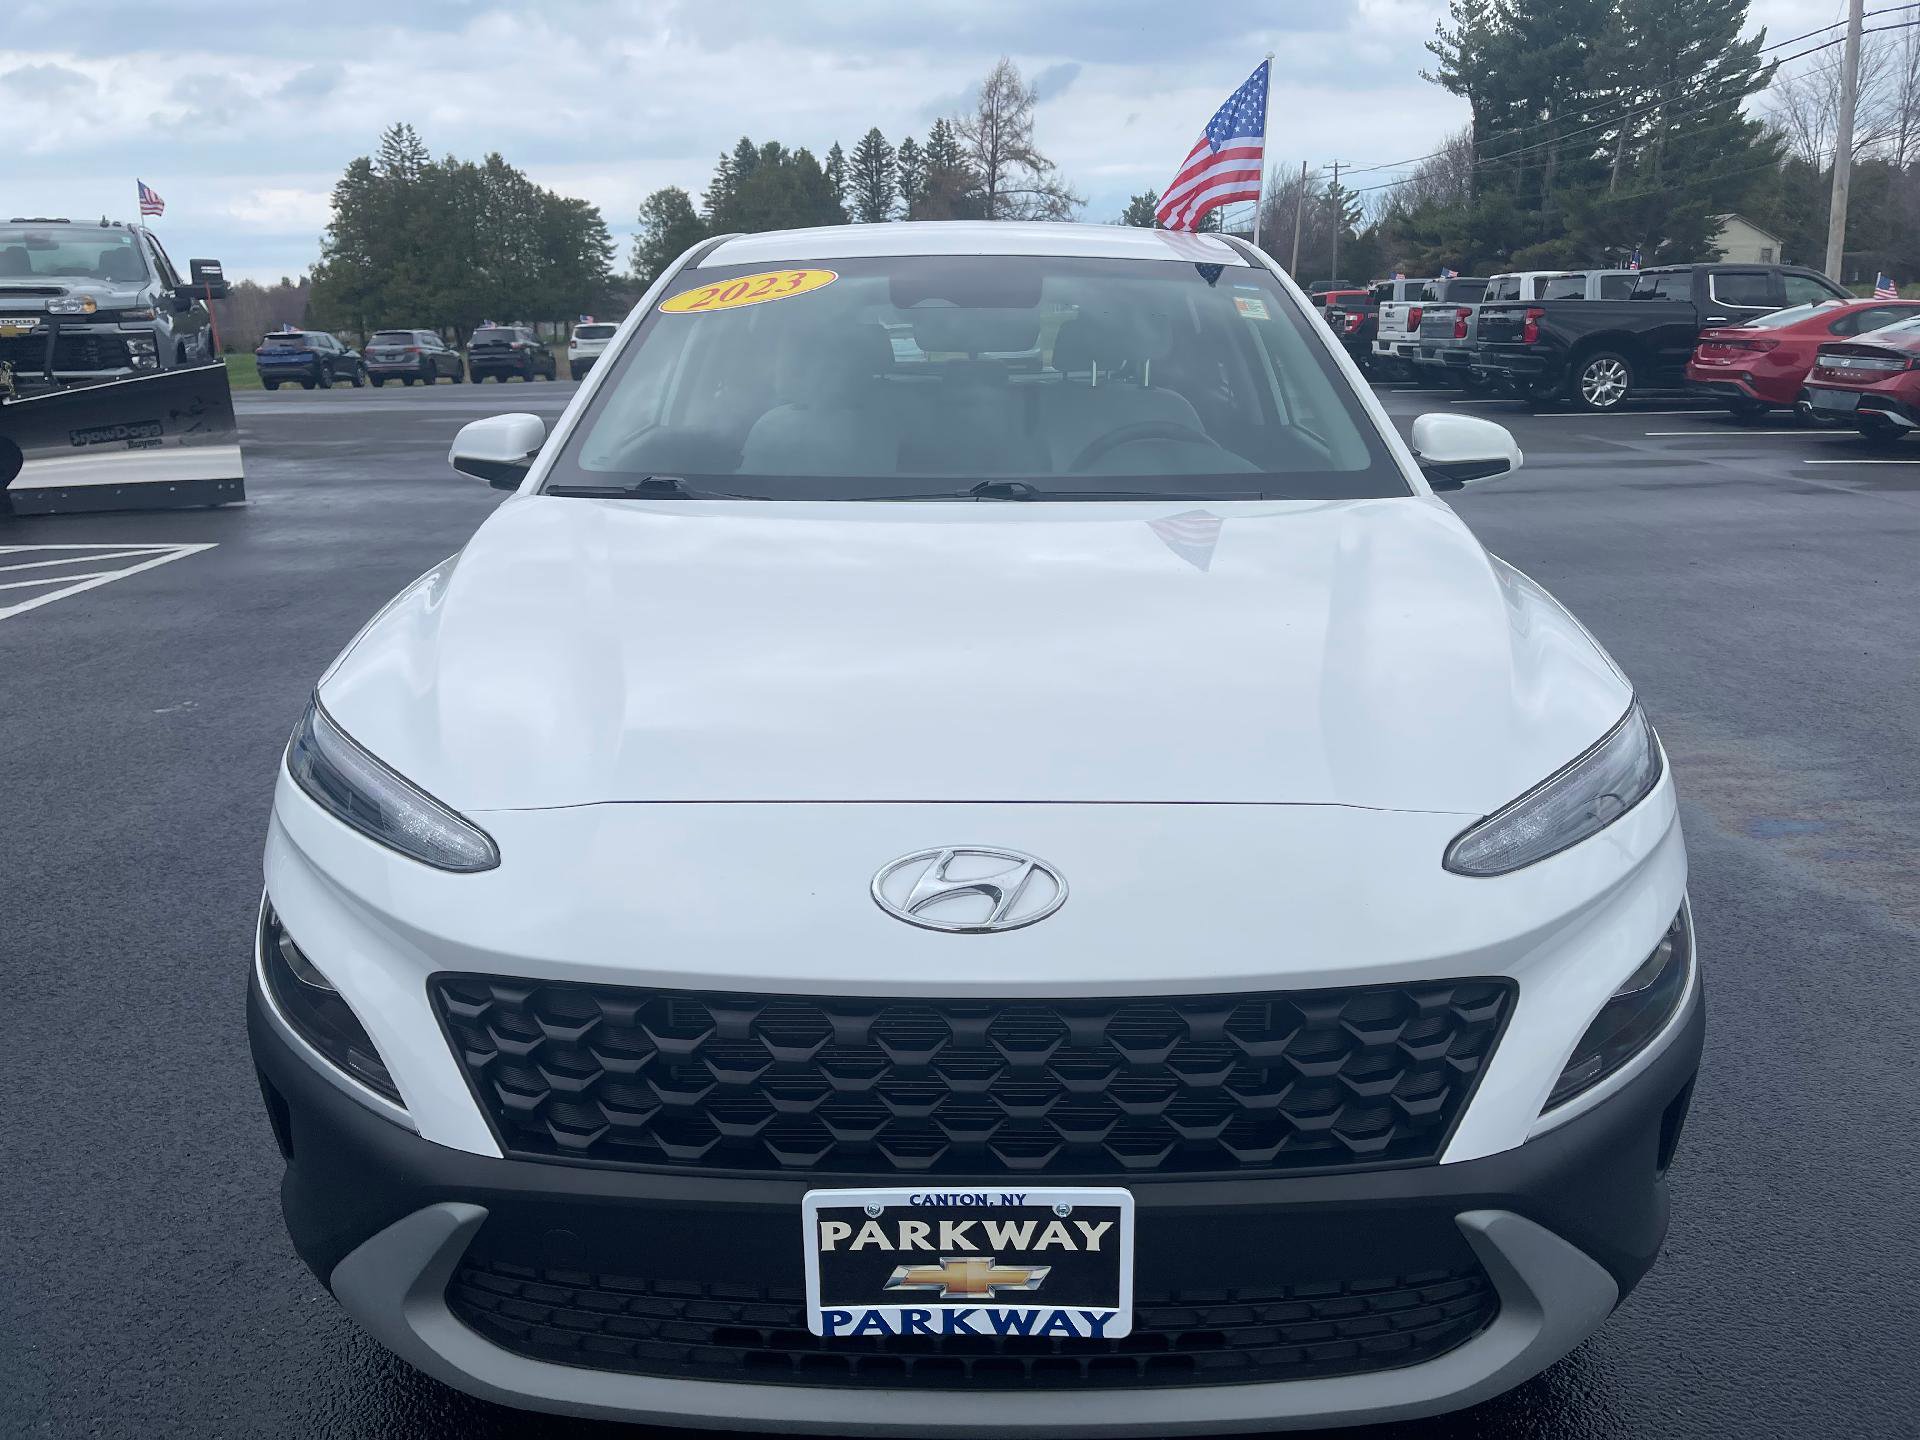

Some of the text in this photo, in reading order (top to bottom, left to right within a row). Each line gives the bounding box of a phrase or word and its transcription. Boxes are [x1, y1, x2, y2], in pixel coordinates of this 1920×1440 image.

[687, 272, 807, 309] 2023
[909, 1193, 1027, 1207] CANTON, NY
[820, 1220, 1114, 1251] PARKWAY
[820, 1308, 1118, 1338] PARKWAY
